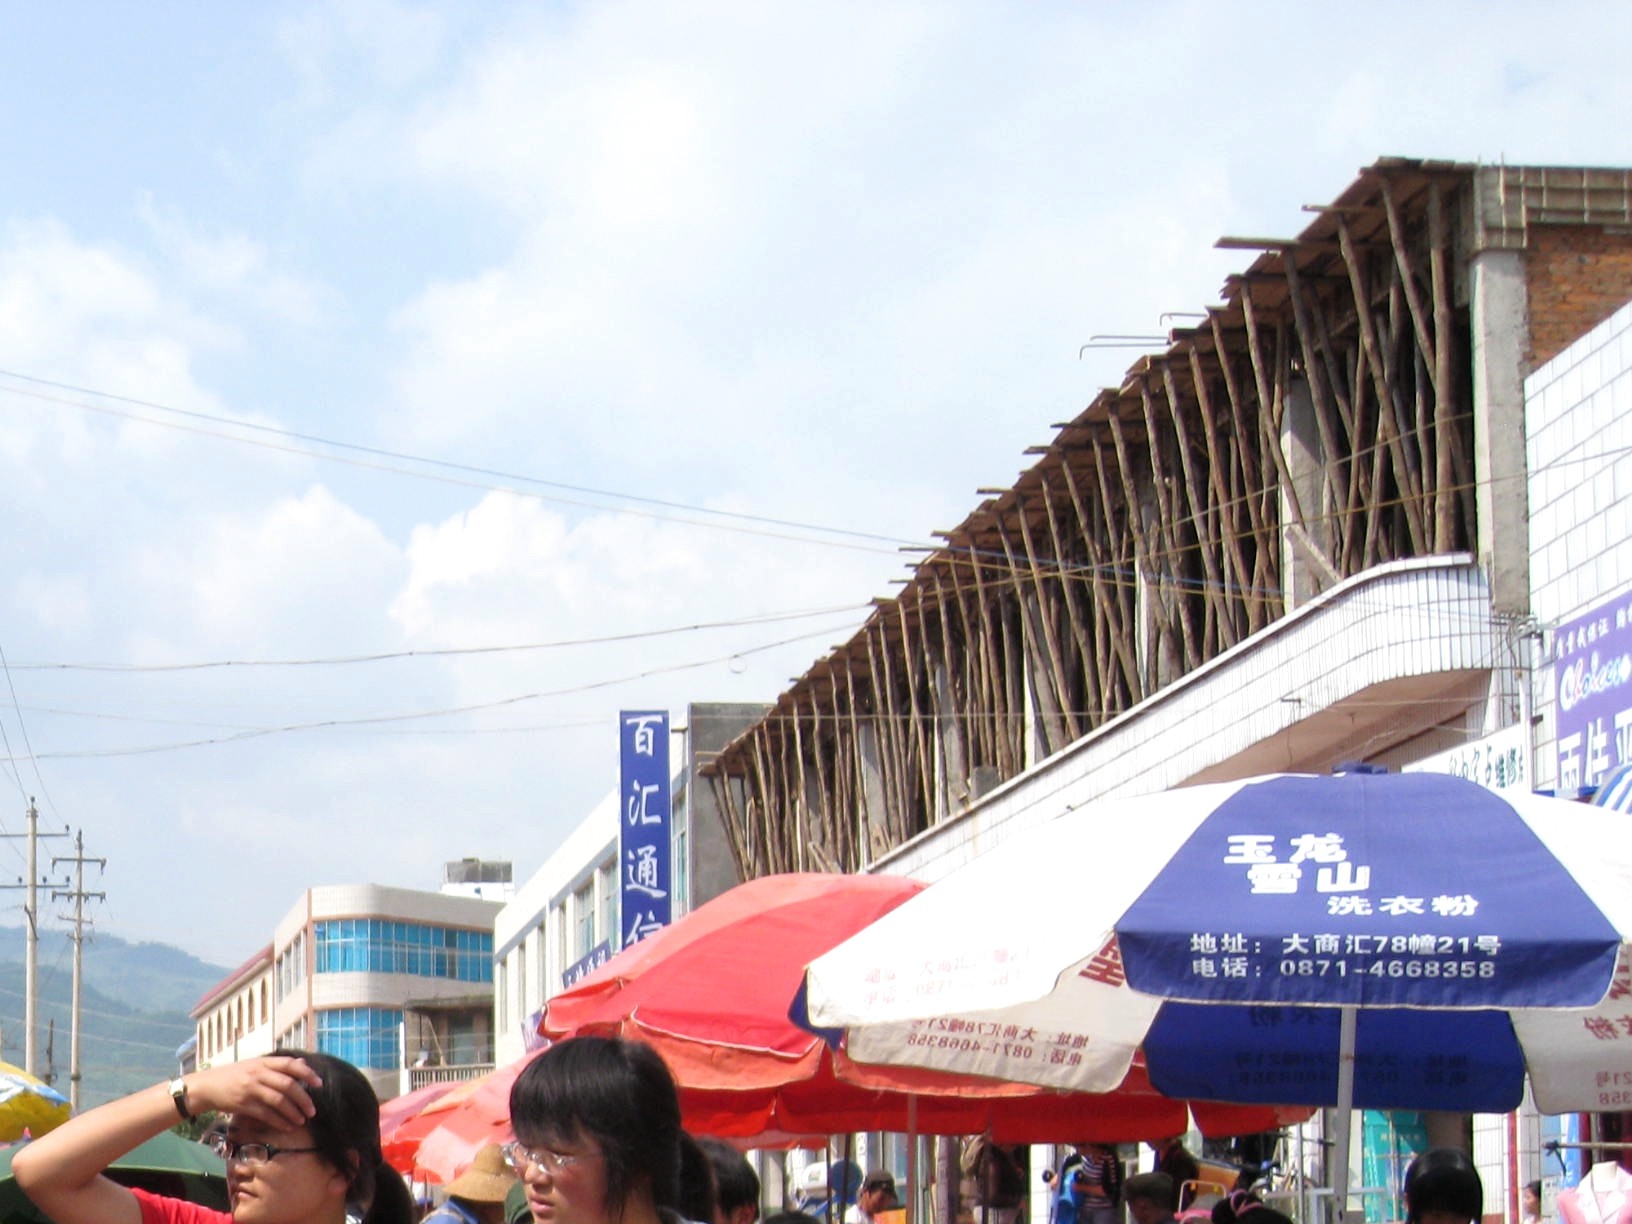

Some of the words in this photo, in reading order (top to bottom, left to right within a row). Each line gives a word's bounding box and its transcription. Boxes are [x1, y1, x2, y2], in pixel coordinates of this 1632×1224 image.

[1224, 833, 1347, 864] 玉龙
[1247, 862, 1370, 893] 雪山
[1327, 894, 1479, 916] 洗衣粉
